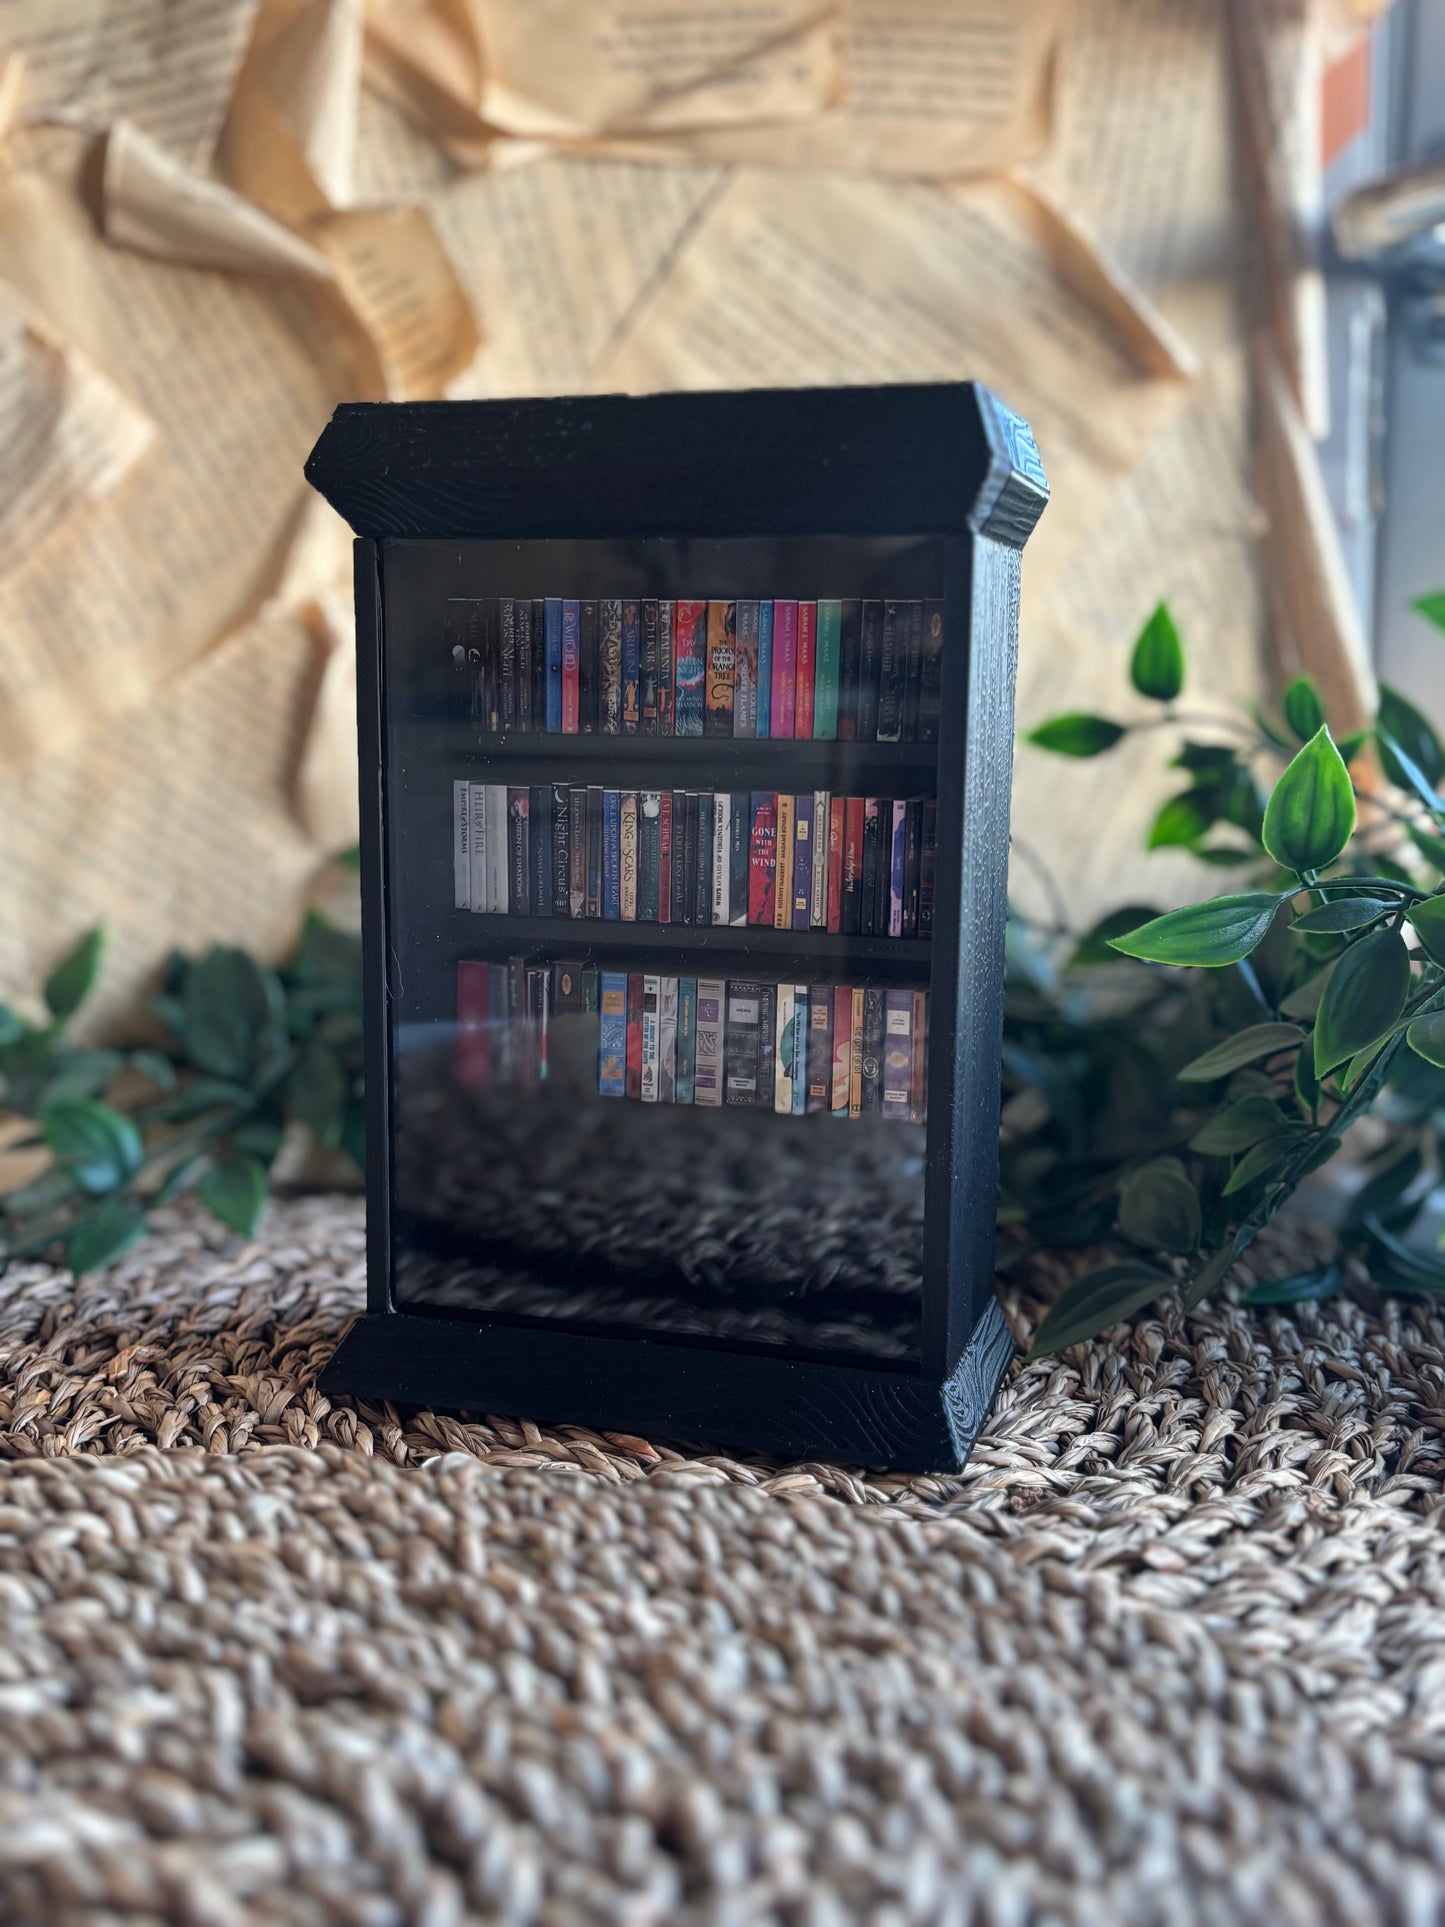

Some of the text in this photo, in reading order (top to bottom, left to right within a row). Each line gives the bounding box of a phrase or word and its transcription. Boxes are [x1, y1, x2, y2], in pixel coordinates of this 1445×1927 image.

[625, 629, 635, 674] ARIADNE
[646, 621, 656, 672] ELEKTRA
[661, 630, 670, 680] ATALANTA
[682, 639, 697, 648] DAY
[502, 647, 510, 677] NIGHT
[714, 672, 731, 680] TREE
[740, 663, 748, 729] SILVER FLAMES
[460, 788, 468, 816] EMPIRE
[474, 791, 484, 821] HEIR
[610, 795, 618, 816] ONCE
[610, 819, 618, 842] UPON
[622, 811, 636, 840] KING
[752, 827, 777, 838] GONE
[475, 830, 485, 856] FIRE
[515, 816, 524, 898] QUEEN OF SHADOWS
[555, 805, 569, 892] Night Circus
[755, 839, 773, 847] WITH
[610, 851, 619, 880] BROKEN
[622, 848, 636, 883] SCARS
[716, 855, 723, 863] OF
[752, 858, 776, 868] WIND
[674, 860, 684, 903] KINGDOM
[845, 860, 856, 892] Watership
[611, 882, 619, 906] HEART
